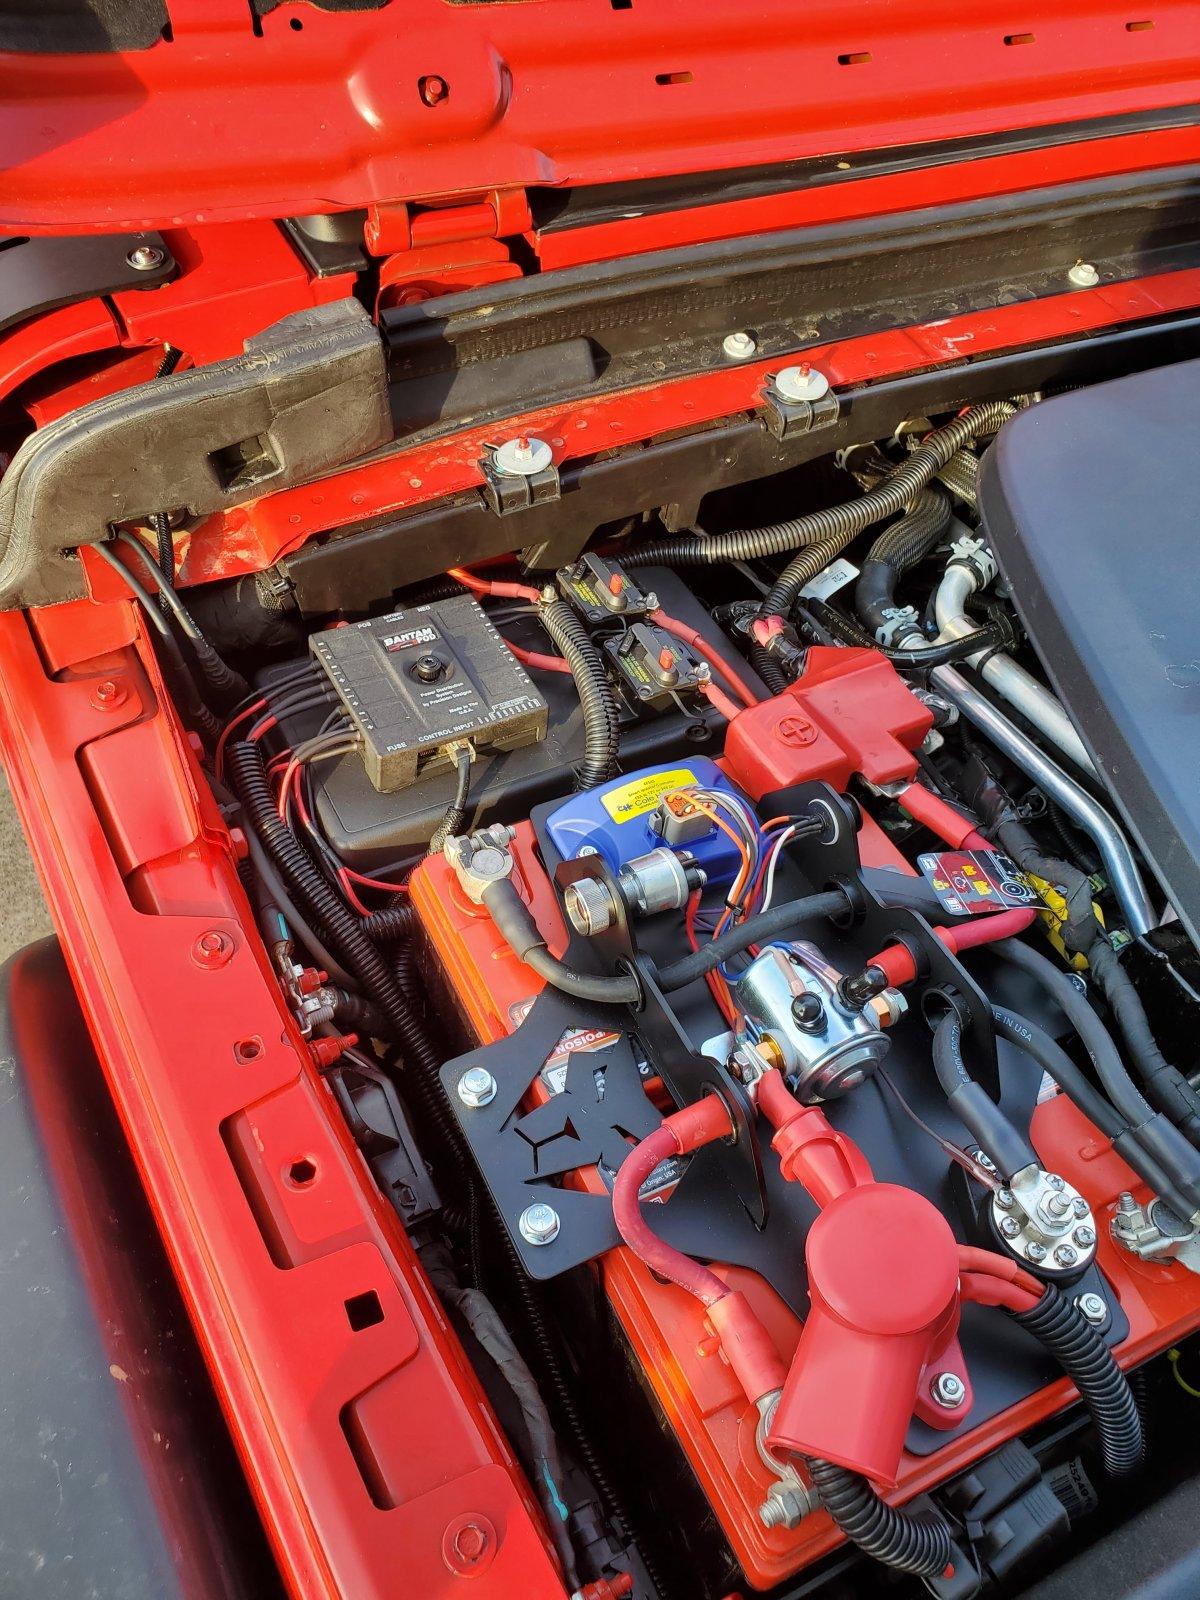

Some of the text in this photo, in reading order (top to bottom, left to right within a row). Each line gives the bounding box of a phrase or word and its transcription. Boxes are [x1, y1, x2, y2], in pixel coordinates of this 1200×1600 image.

[383, 627, 432, 647] BANTAM
[415, 633, 437, 644] POD
[418, 721, 474, 742] CONTROL INPUT
[386, 742, 408, 752] FUSE
[1003, 1016, 1014, 1027] IN
[1014, 1023, 1033, 1042] USA
[555, 1031, 604, 1054] POISON
[664, 1169, 677, 1178] USA
